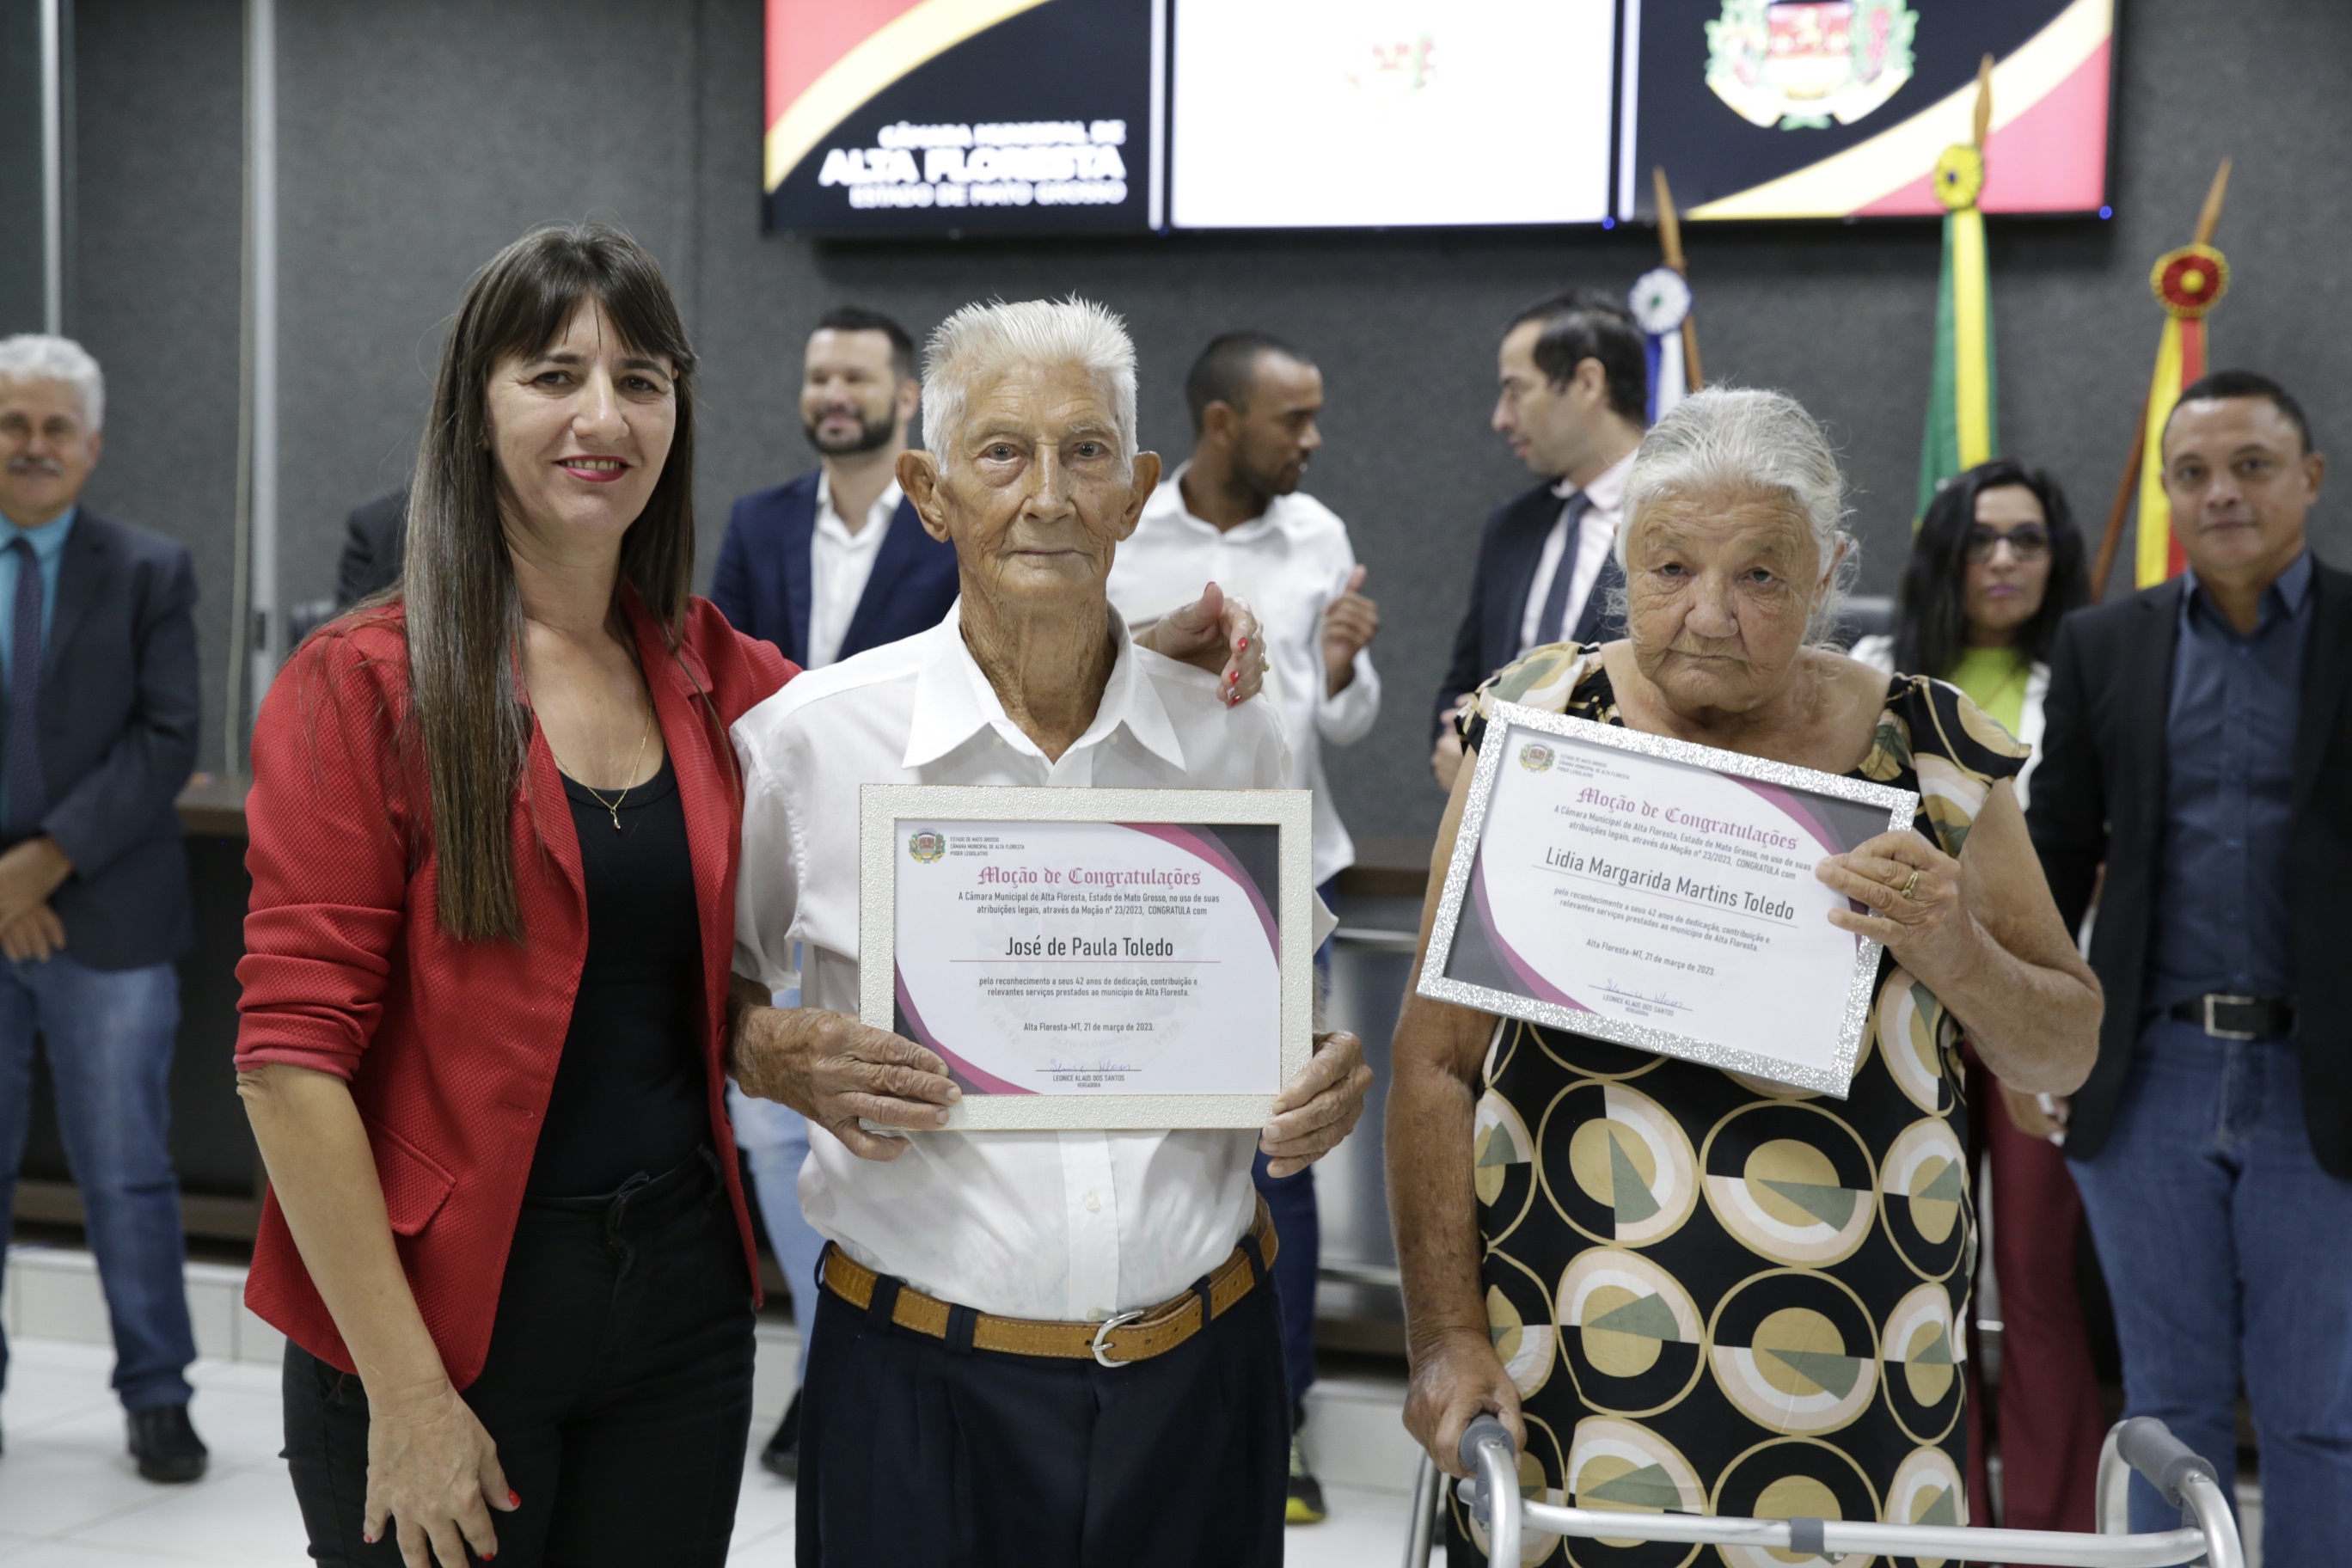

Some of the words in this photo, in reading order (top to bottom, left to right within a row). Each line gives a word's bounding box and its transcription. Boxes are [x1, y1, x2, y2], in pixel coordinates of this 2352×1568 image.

[818, 148, 920, 186] ALTA
[923, 144, 1126, 184] FLORESTA
[1576, 787, 1636, 813] Moção
[1640, 800, 1659, 818] de
[1664, 807, 1798, 850] Congratulações
[1553, 804, 1559, 813] A
[1560, 805, 1588, 819] Câmara
[1588, 812, 1622, 827] Municipal
[1622, 820, 1632, 830] de
[1632, 822, 1648, 833] Alta
[1648, 825, 1678, 842] Floresta,
[1680, 832, 1704, 846] Estado
[1704, 838, 1713, 848] de
[1714, 841, 1732, 853] Mato
[1733, 845, 1758, 860] Grosso,
[1760, 853, 1769, 861] no
[1770, 855, 1783, 865] uso
[1784, 857, 1793, 867] de
[1794, 861, 1811, 872] suas
[1568, 821, 1607, 836] atribuições
[1608, 829, 1630, 843] legais,
[1632, 836, 1658, 848] através
[1659, 841, 1669, 851] da
[1669, 842, 1692, 856] Moção
[1702, 850, 1732, 867] 23/2023,
[1736, 858, 1779, 876] CONGRATULA
[1780, 871, 1796, 879] com
[958, 891, 963, 901] A
[965, 891, 993, 901] Câmara
[994, 891, 1028, 903] Municipal
[1030, 891, 1039, 901] de
[1040, 891, 1055, 901] Alta
[1057, 891, 1087, 903] Floresta,
[1088, 891, 1112, 902] Estado
[1113, 891, 1122, 902] de
[1124, 892, 1141, 902] Mato
[1142, 892, 1167, 903] Grosso,
[1192, 893, 1202, 903] de
[977, 866, 1038, 889] Moção
[1044, 867, 1062, 884] de
[1068, 867, 1201, 890] Congratulações
[1546, 846, 1584, 872] Lidia
[1588, 856, 1671, 891] Margarida
[1675, 876, 1738, 907] Martins
[1743, 891, 1794, 920] Toledo
[977, 903, 1016, 916] atribuições
[1017, 904, 1040, 916] legais,
[1042, 903, 1069, 914] através
[1070, 904, 1080, 914] da
[1081, 904, 1104, 916] Moção
[1114, 904, 1144, 916] 23/2023,
[1148, 905, 1191, 915] CONGRATULA
[1553, 887, 1569, 897] pelo
[1570, 891, 1623, 910] reconhecimento
[1630, 905, 1646, 915] seus
[1647, 908, 1657, 917] 42
[1657, 912, 1674, 922] anos
[1675, 914, 1684, 923] de
[1685, 916, 1720, 933] dedicação,
[1721, 927, 1764, 942] contribuição
[1559, 899, 1595, 913] relevantes
[1596, 908, 1625, 921] serviços
[1625, 915, 1659, 928] prestados
[1669, 925, 1703, 939] município
[1703, 932, 1712, 940] de
[1713, 934, 1728, 945] Alta
[1729, 937, 1758, 952] Floresta.
[1005, 934, 1041, 956] José
[1047, 936, 1066, 956] de
[1072, 937, 1117, 956] Paula
[1122, 937, 1173, 956] Toledo
[1585, 938, 1601, 949] Alta
[1601, 941, 1643, 960] Floresta-MT,
[1645, 952, 1653, 961] 21
[1653, 954, 1663, 964] de
[1663, 958, 1686, 970] março
[1686, 962, 1695, 971] de
[1696, 964, 1714, 976] 2023.
[978, 976, 994, 987] pelo
[995, 977, 1050, 985] reconhecimento
[1075, 977, 1084, 985] 42
[1103, 977, 1112, 985] de
[1113, 977, 1148, 988] dedicação,
[1150, 977, 1191, 988] contribuição
[987, 987, 1024, 996] relevantes
[1026, 987, 1054, 998] serviços
[1056, 987, 1089, 998] prestados
[1100, 987, 1133, 998] município
[1135, 988, 1143, 996] de
[1144, 987, 1159, 996] Alta
[1160, 988, 1189, 996] Floresta.
[1023, 1022, 1038, 1031] Alta
[1039, 1022, 1082, 1032] Floresta-MT,
[1083, 1022, 1091, 1031] 21
[1092, 1022, 1101, 1031] de
[1102, 1024, 1124, 1033] março
[1125, 1022, 1134, 1031] de
[1136, 1022, 1154, 1032] 2023.
